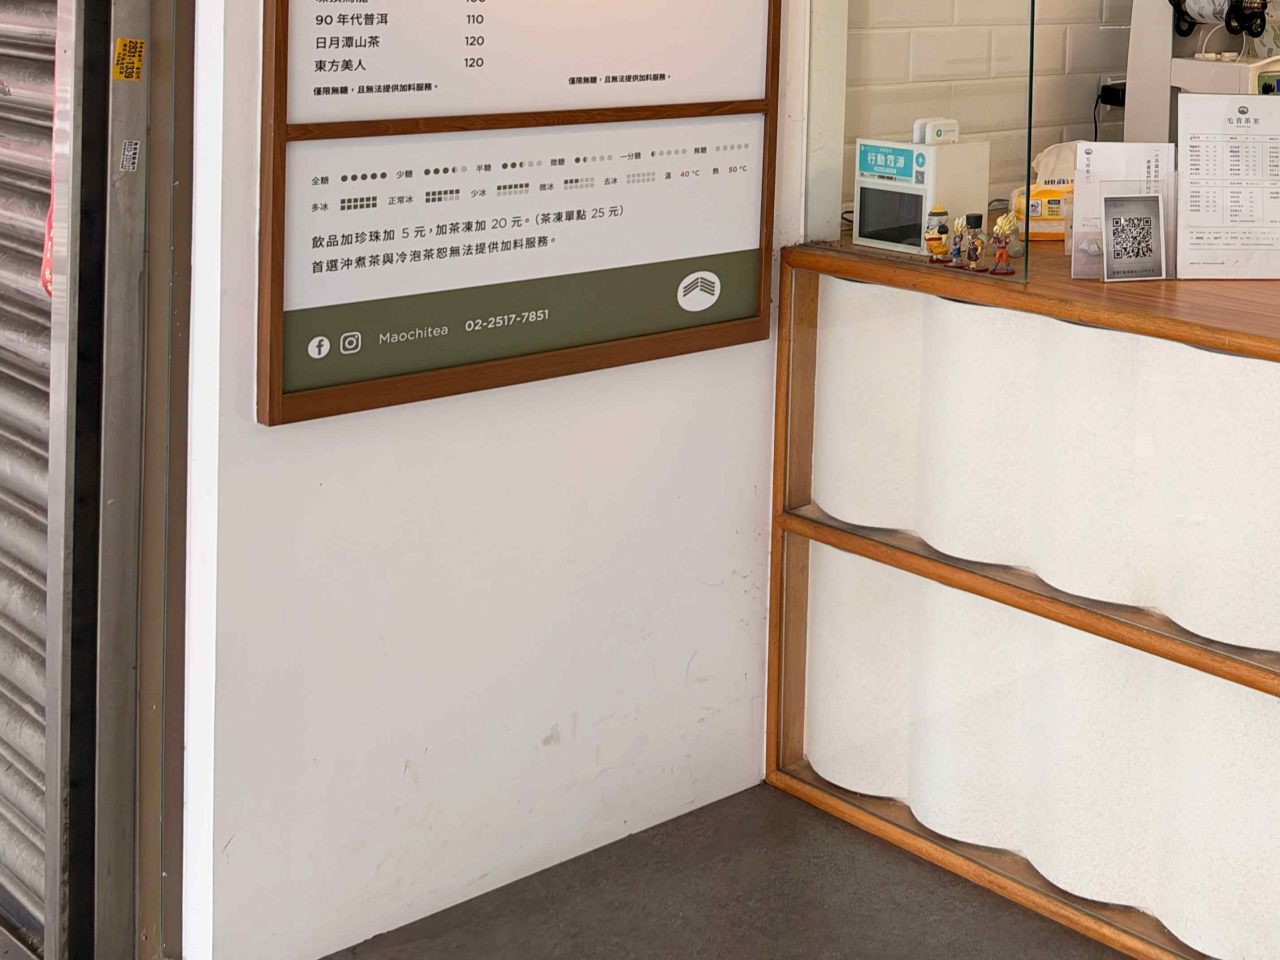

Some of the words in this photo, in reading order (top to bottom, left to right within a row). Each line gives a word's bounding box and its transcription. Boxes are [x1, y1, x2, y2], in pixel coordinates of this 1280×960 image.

[467, 15, 484, 24] 110
[316, 36, 380, 49] 日月潭山茶
[465, 36, 484, 46] 120
[314, 60, 366, 72] 東方美人
[465, 58, 484, 67] 120
[379, 326, 449, 344] Maochitea
[465, 308, 549, 331] 02-2517-7851
